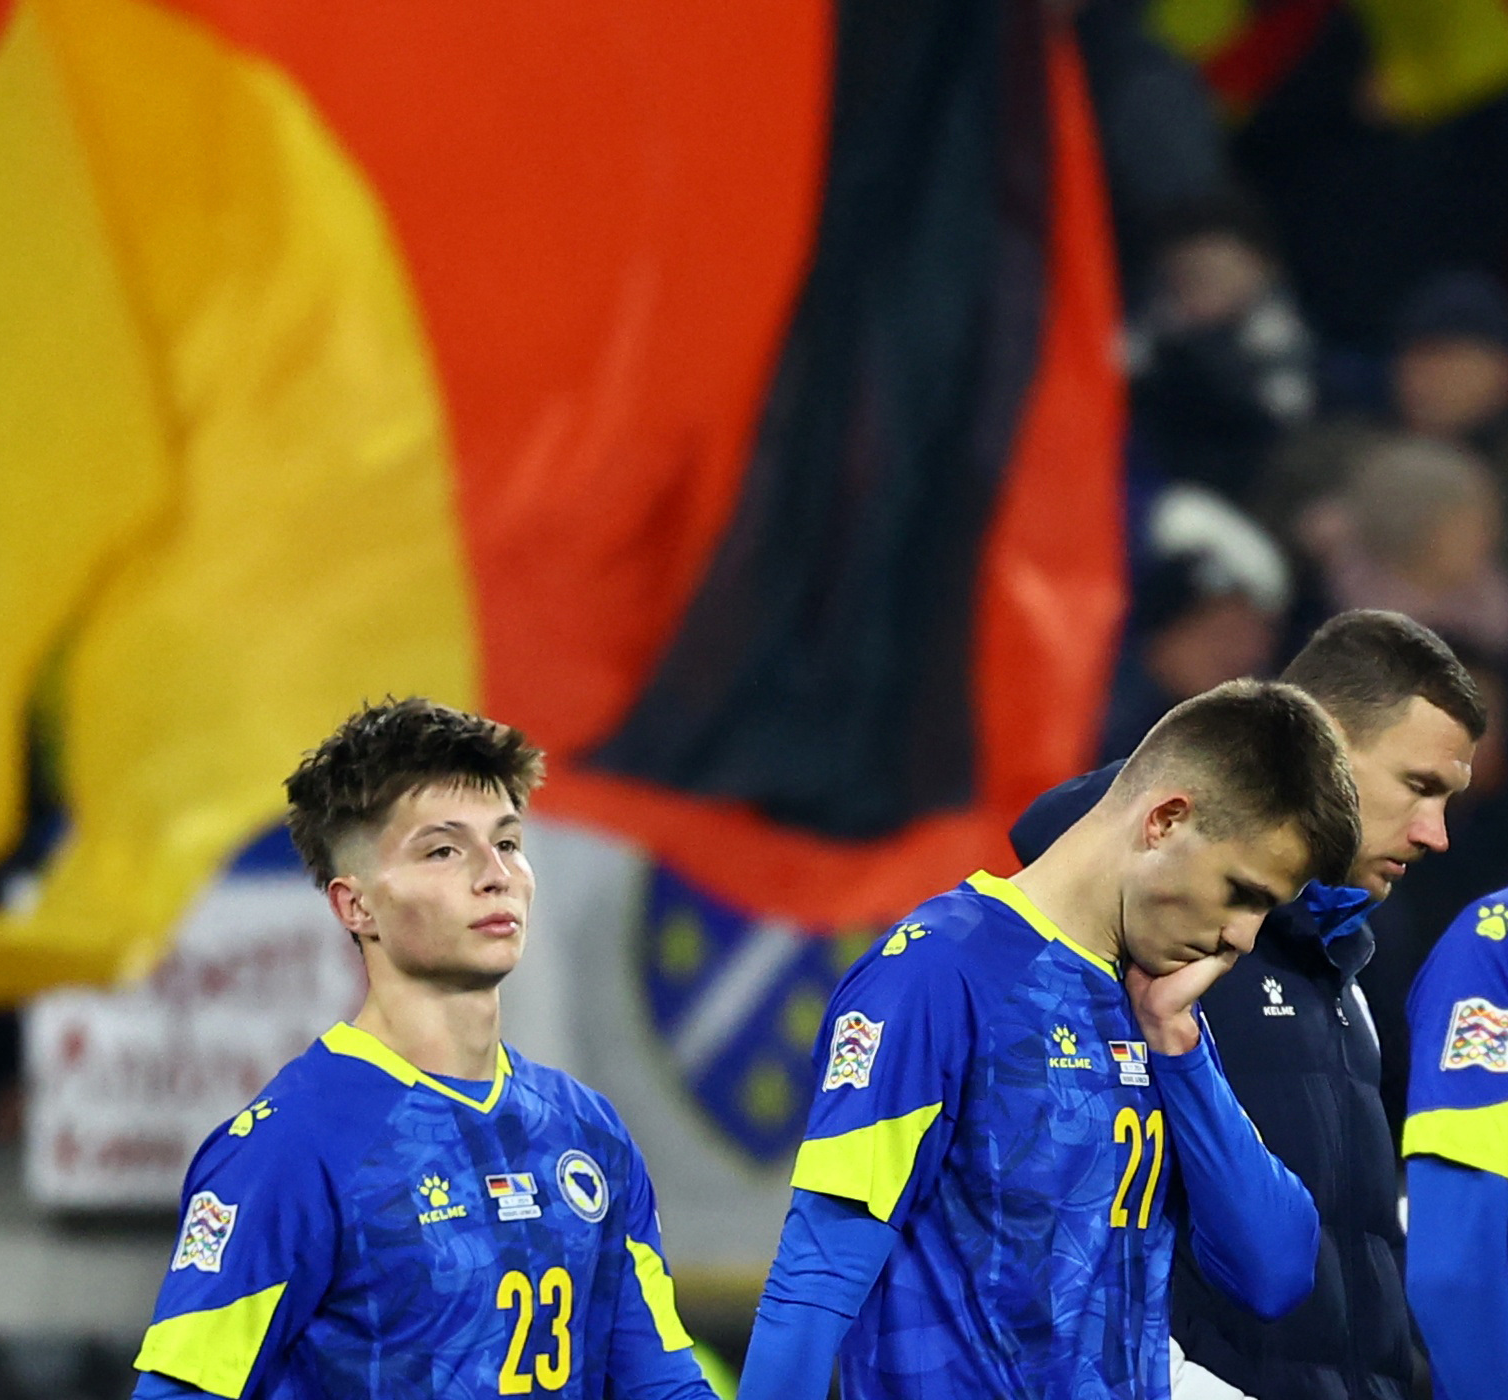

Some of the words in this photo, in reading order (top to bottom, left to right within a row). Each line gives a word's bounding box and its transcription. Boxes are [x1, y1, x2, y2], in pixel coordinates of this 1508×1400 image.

[1262, 1006, 1295, 1016] KELME
[1049, 1057, 1093, 1069] KELME
[1109, 1106, 1165, 1230] 21
[418, 1204, 468, 1225] KELME
[496, 1266, 573, 1396] 23
